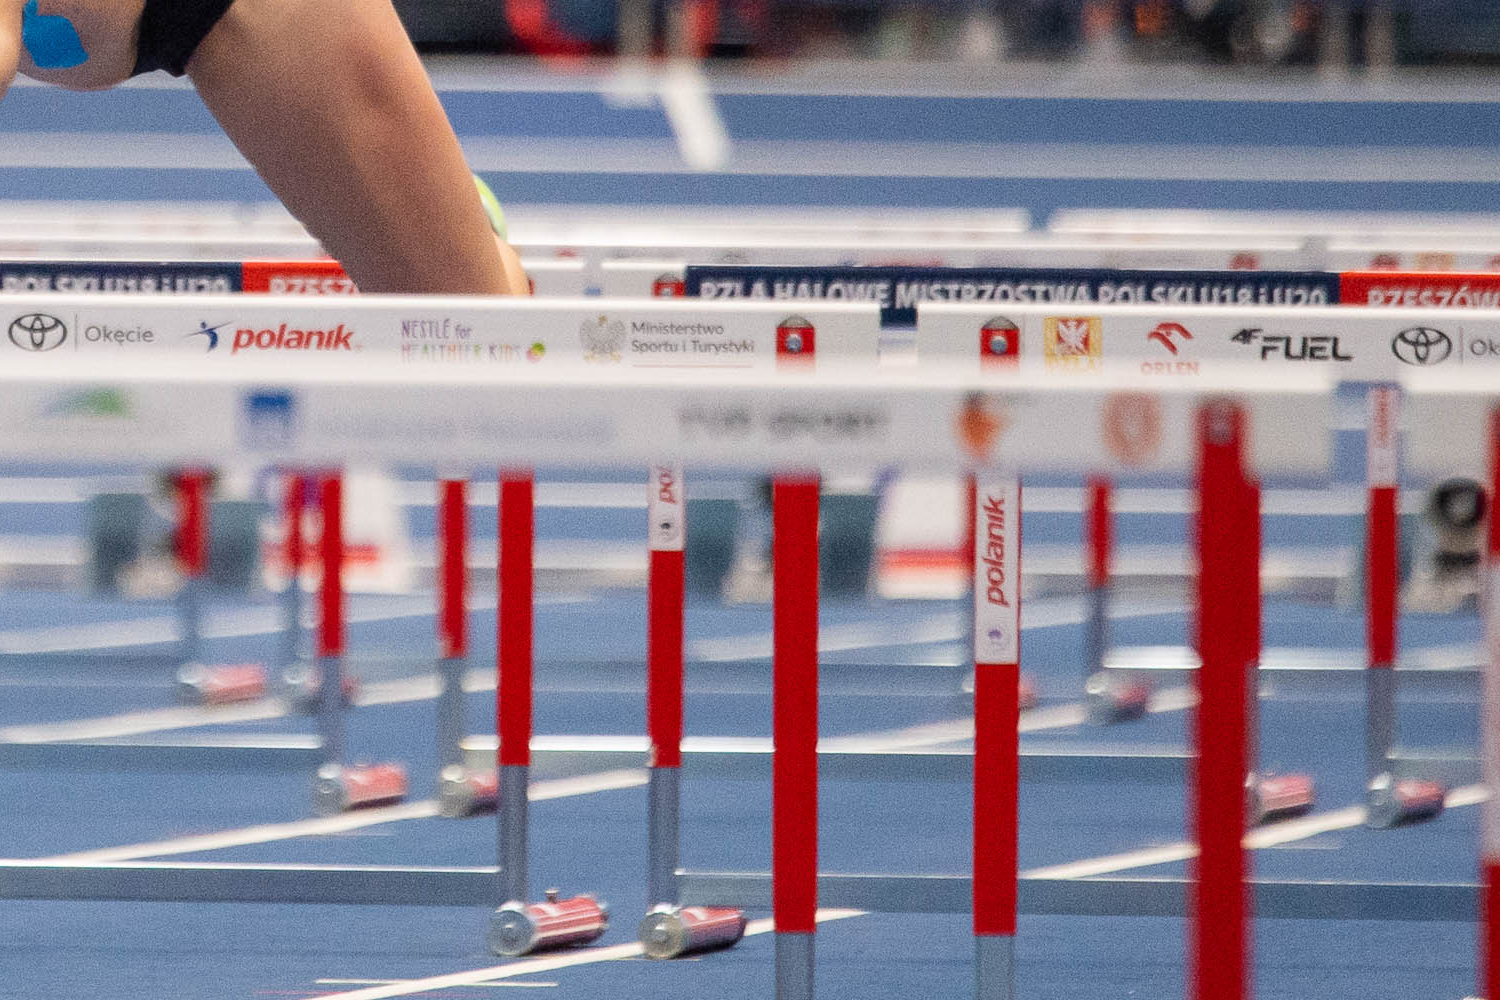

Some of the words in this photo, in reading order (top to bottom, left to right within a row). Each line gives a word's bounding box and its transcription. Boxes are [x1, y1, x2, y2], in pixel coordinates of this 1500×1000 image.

[85, 325, 155, 345] Okęcie
[231, 323, 355, 356] polanik
[402, 318, 451, 340] NESTLÉ
[455, 323, 473, 339] for
[631, 321, 724, 336] Ministerstwo
[631, 339, 679, 355] Sportu
[690, 339, 755, 355] Turystyki
[1261, 335, 1354, 362] FUEL
[987, 495, 1010, 607] polanik
